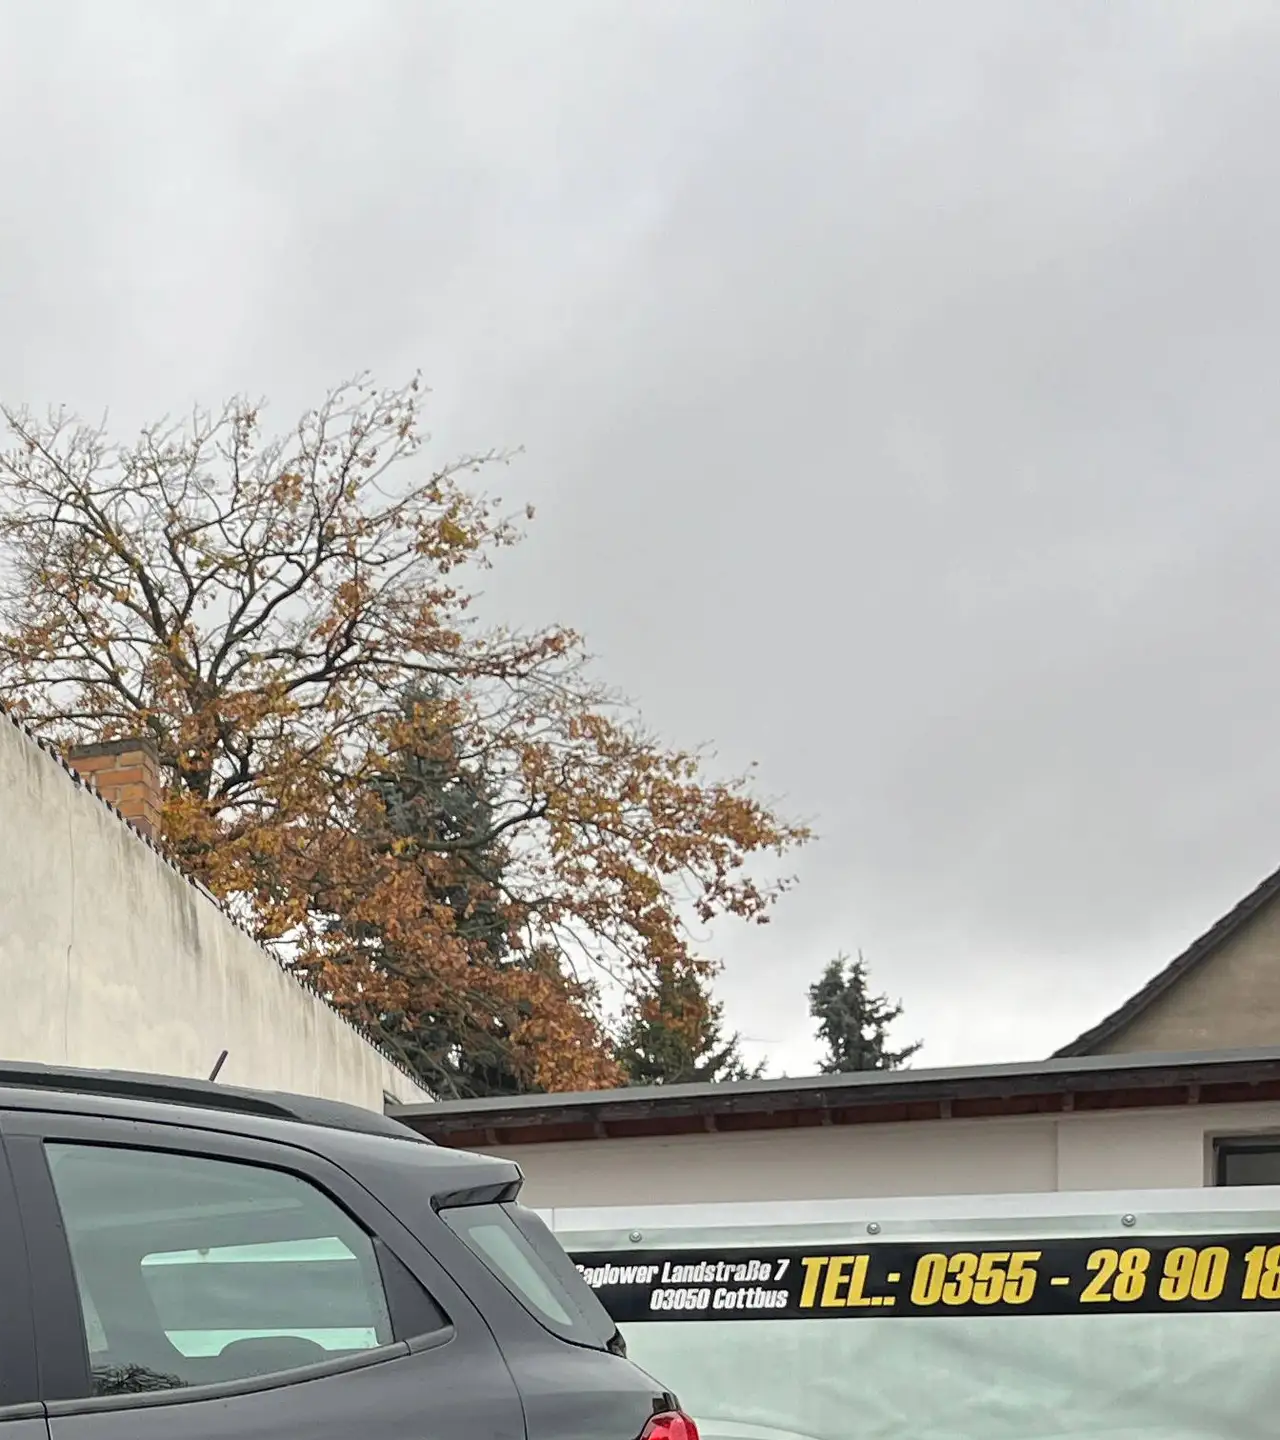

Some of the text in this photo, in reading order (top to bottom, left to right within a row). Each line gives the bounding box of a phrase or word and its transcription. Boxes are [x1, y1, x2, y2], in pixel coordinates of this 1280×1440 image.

[661, 1260, 771, 1284] Landstraße
[774, 1259, 790, 1280] 7
[910, 1251, 1041, 1306] 0355
[1080, 1248, 1151, 1304] 28
[1159, 1247, 1229, 1302] 90
[650, 1287, 788, 1310] 03050 Cottbus
